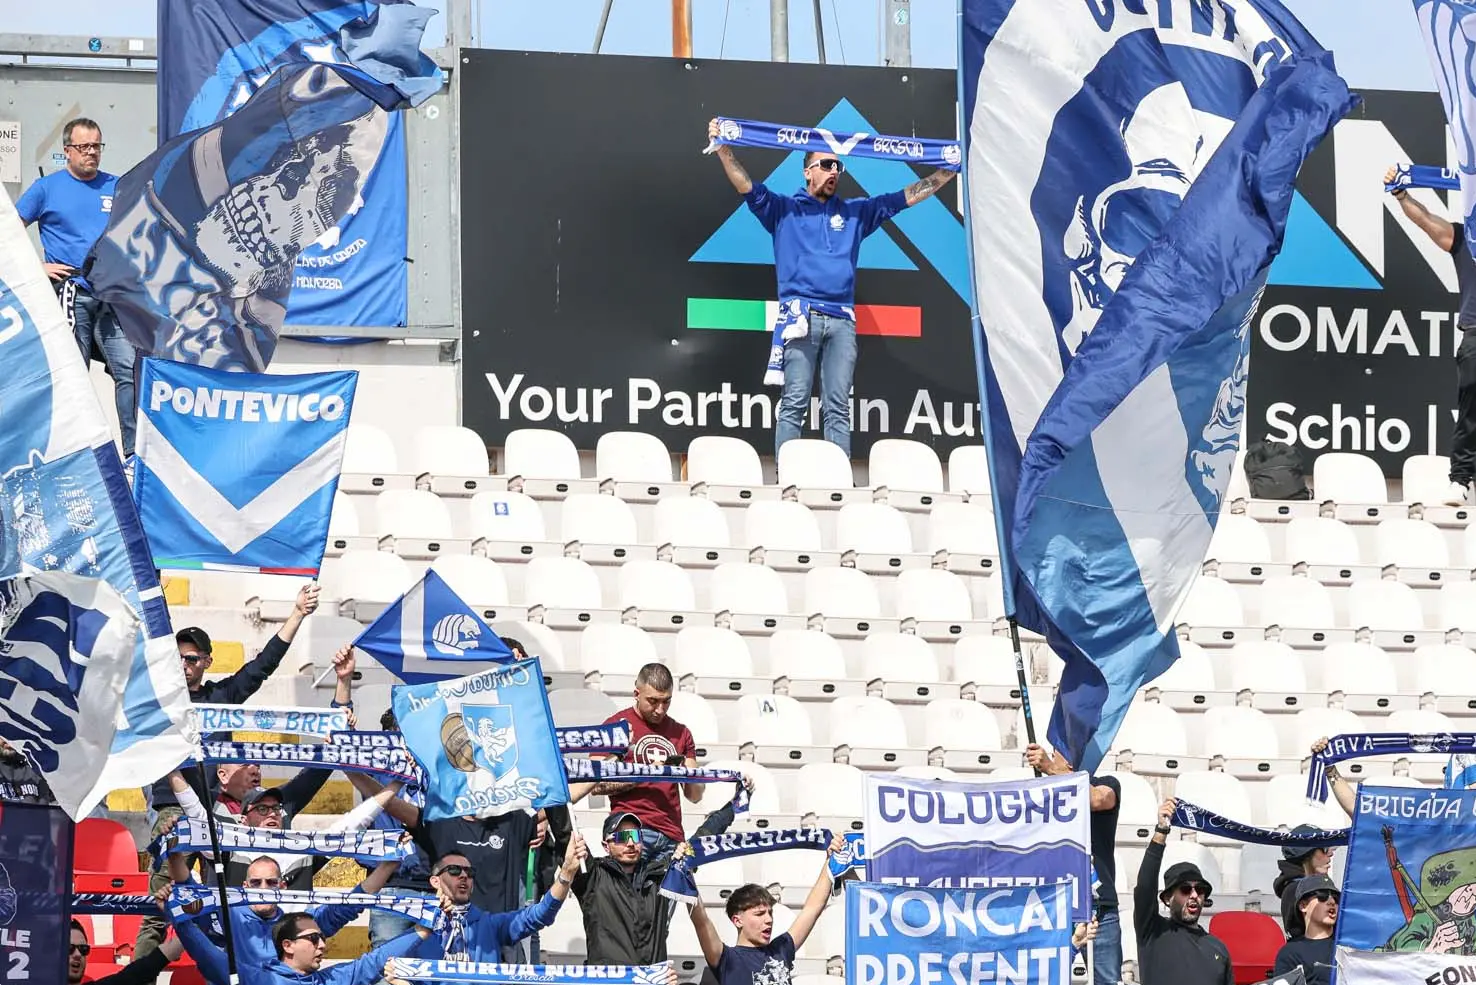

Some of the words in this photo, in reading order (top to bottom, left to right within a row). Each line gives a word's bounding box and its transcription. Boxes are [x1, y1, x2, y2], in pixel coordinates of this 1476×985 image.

[776, 127, 810, 145] SOLO
[150, 380, 345, 424] PONTEVICO
[485, 371, 606, 424] Your
[850, 396, 891, 433] in
[1265, 402, 1412, 452] Schio
[244, 743, 314, 761] NORD
[877, 785, 1078, 825] COLOGNE
[701, 827, 826, 856] BRESCIA
[437, 960, 537, 978] CURVA
[546, 963, 627, 979] NORD
